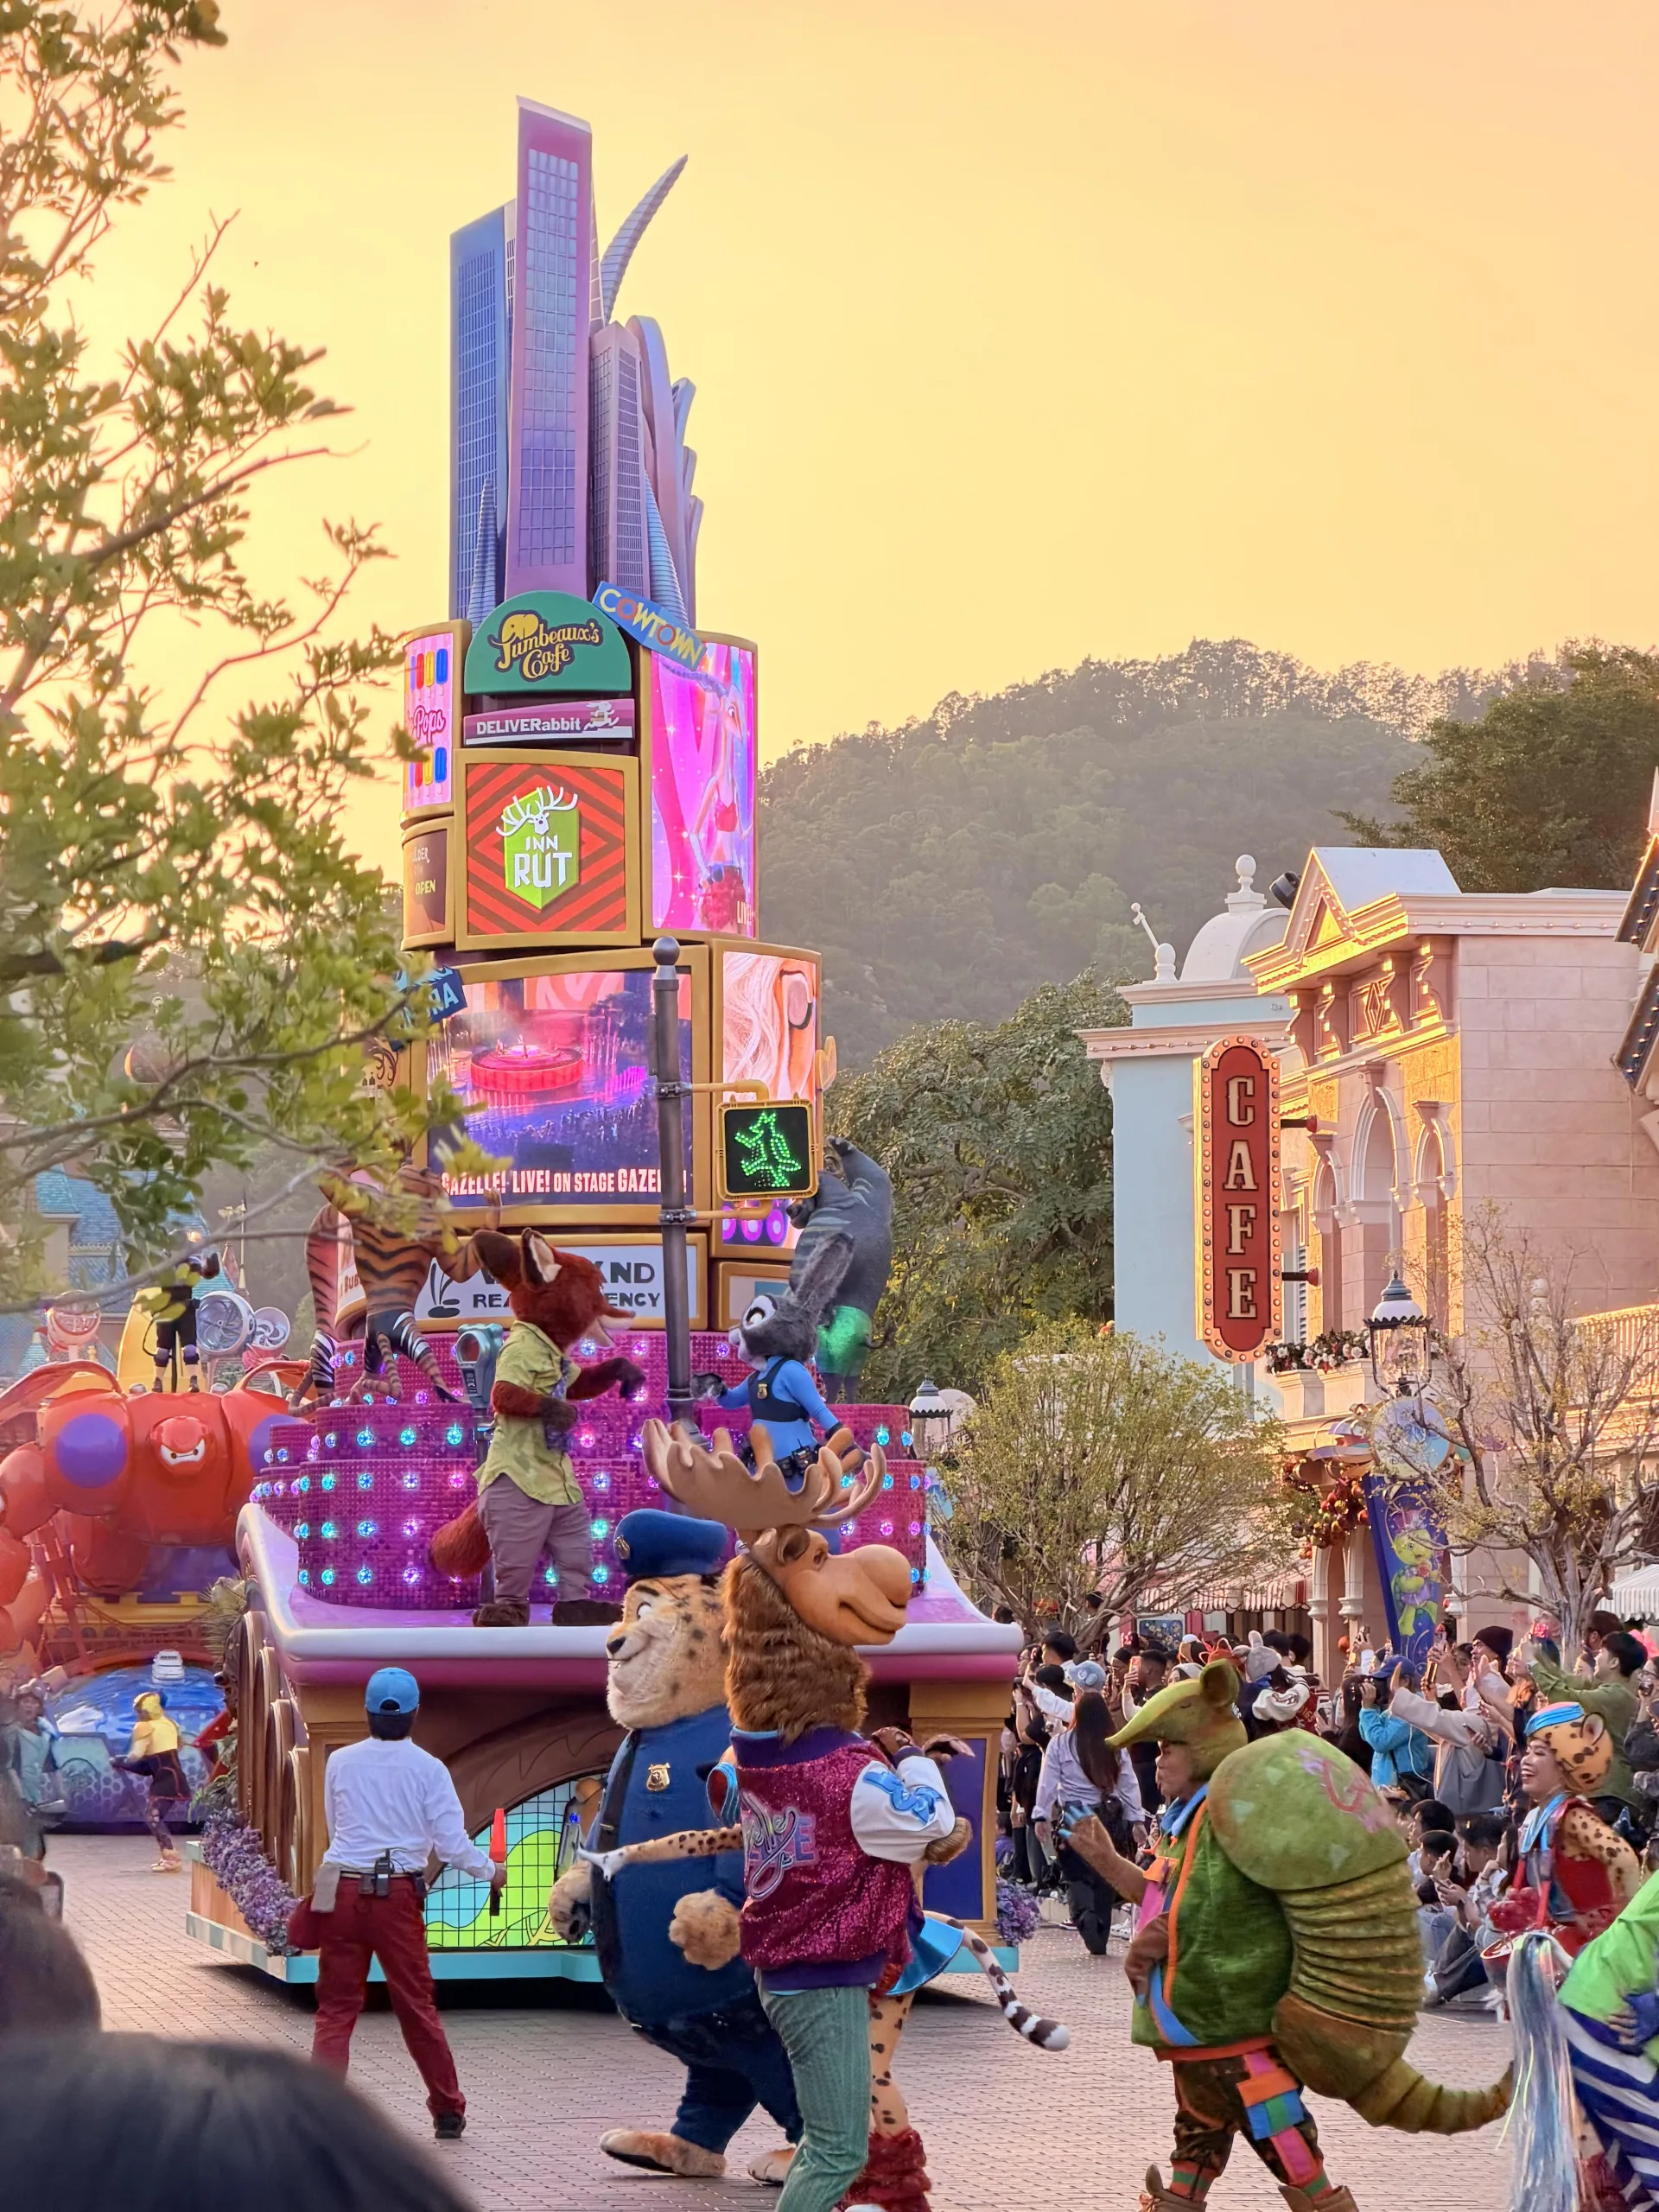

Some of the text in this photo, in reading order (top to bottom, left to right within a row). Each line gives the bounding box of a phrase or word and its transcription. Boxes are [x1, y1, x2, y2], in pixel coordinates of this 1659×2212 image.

[492, 621, 600, 670] Jumbeaux's
[600, 588, 703, 668] COWTOWN
[522, 642, 571, 679] Cafe
[413, 705, 446, 744] Pops
[476, 717, 582, 735] DELIVERabbit
[525, 834, 558, 854] INN
[415, 879, 436, 895] OPEN
[514, 851, 573, 888] RUT
[512, 1170, 550, 1193] LIVE!
[554, 1173, 571, 1192] ON
[574, 1173, 615, 1192] STAGE
[1223, 1076, 1258, 1319] CAFE
